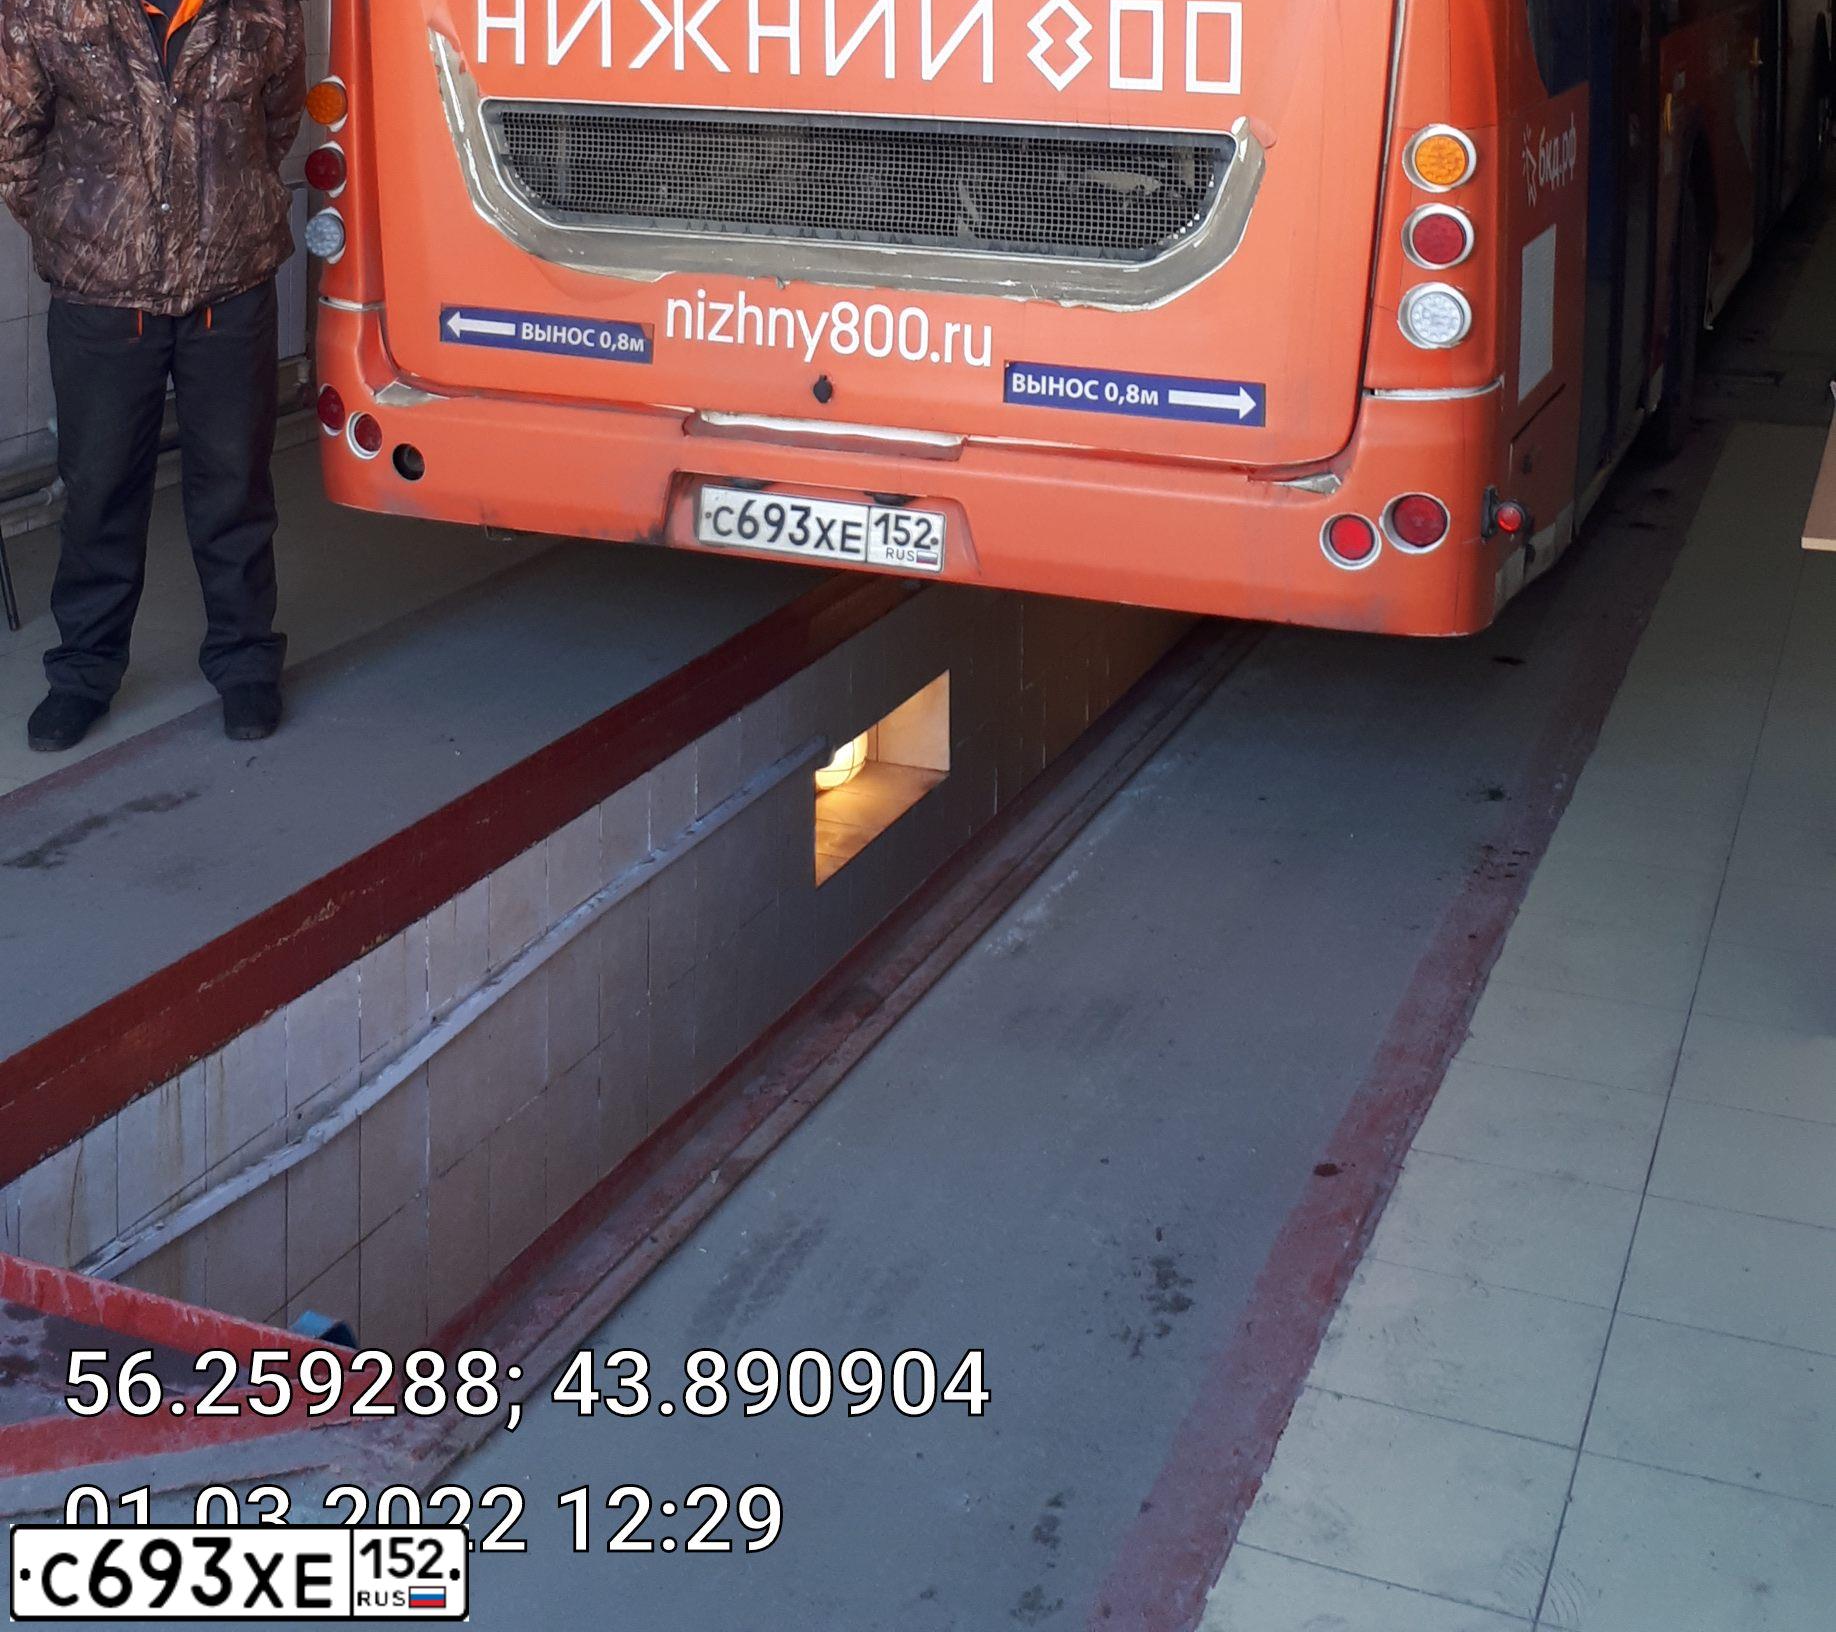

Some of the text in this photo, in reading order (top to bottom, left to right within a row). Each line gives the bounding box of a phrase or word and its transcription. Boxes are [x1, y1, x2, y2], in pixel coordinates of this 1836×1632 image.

[521, 322, 645, 353] ВЫНОС 0,8м
[665, 288, 992, 367] nizhny800.ru
[1011, 372, 1160, 406] ВЫНОС 0,8м
[712, 499, 933, 554] С693ХЕ 152
[885, 546, 915, 562] RUS
